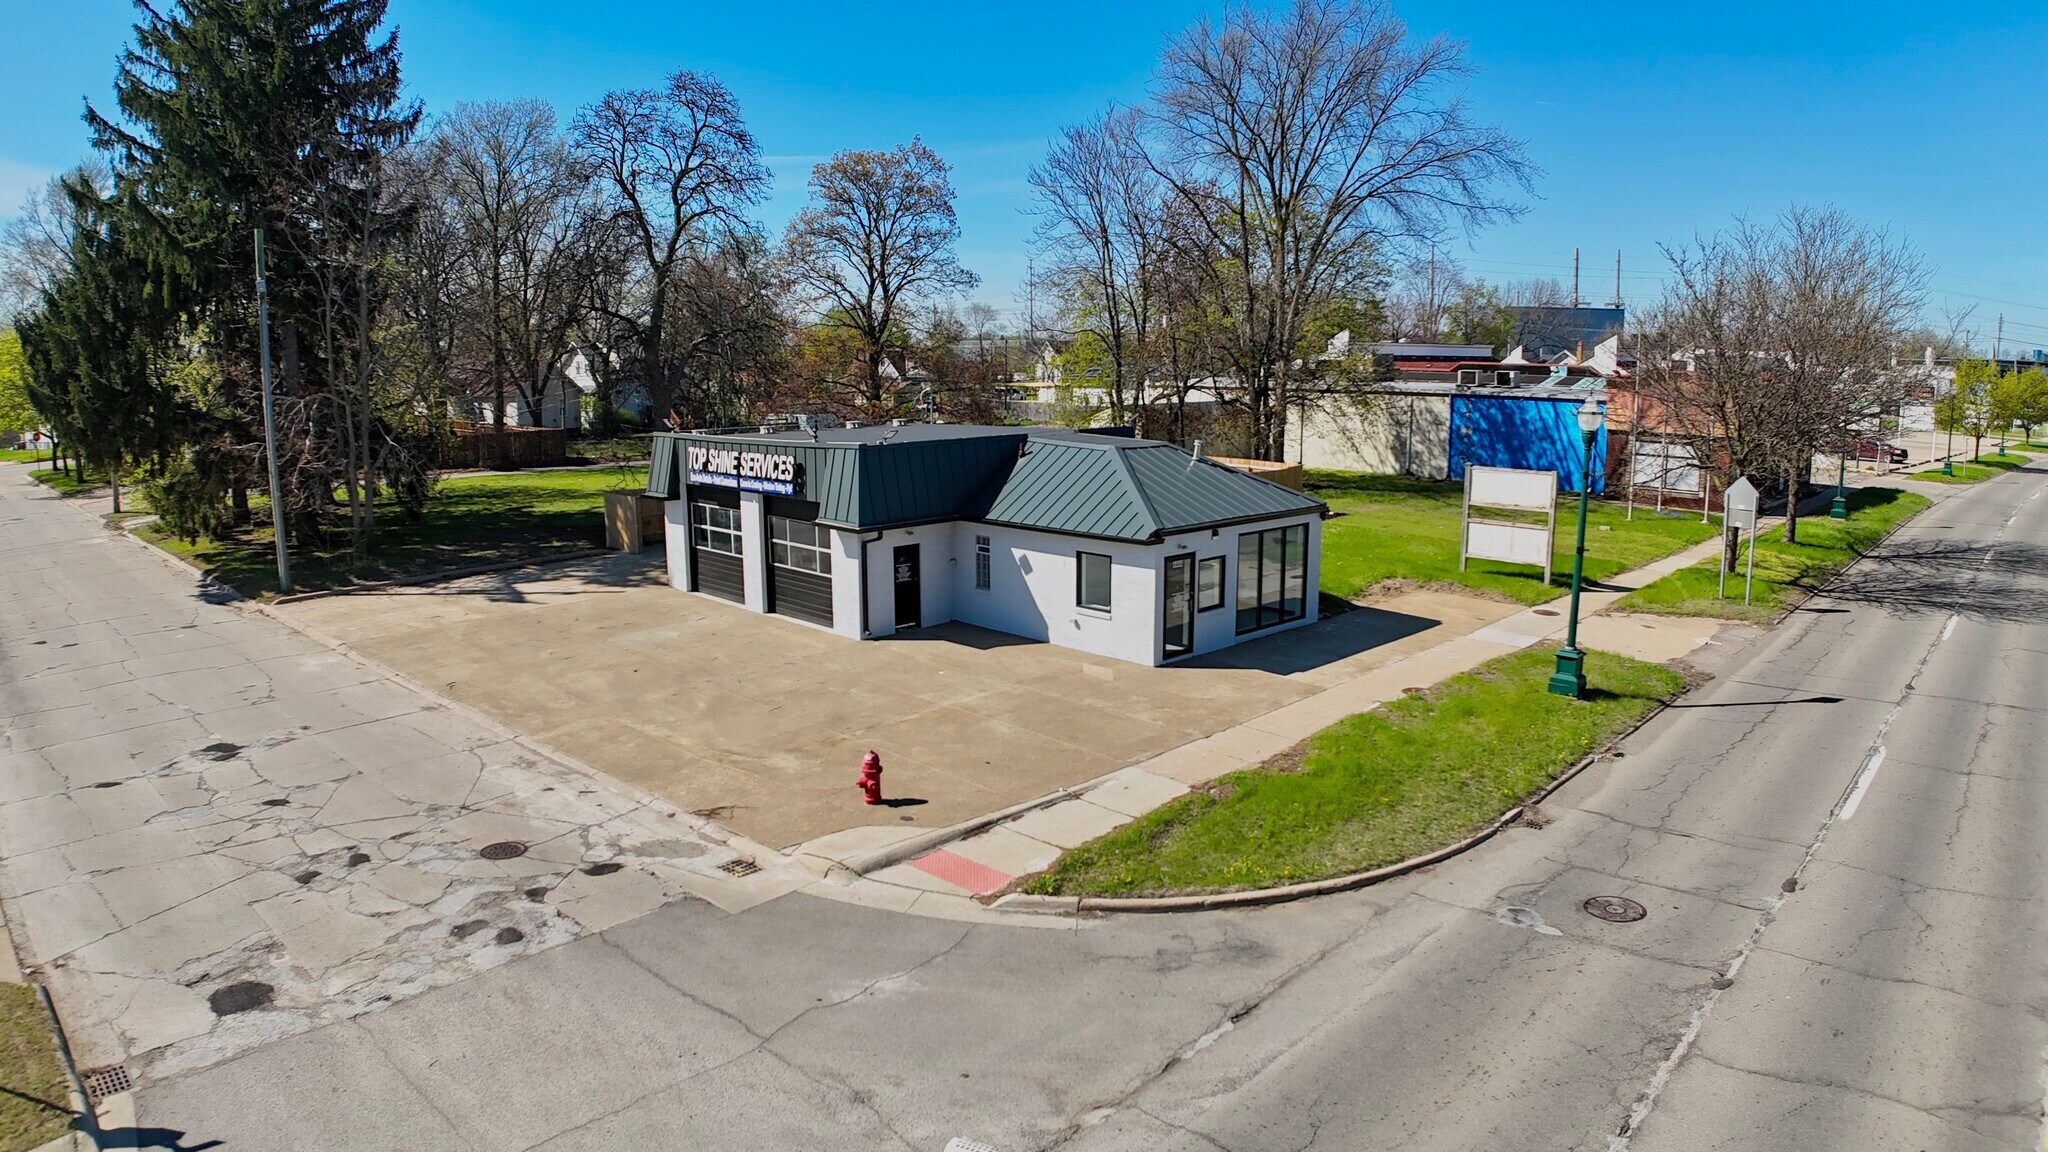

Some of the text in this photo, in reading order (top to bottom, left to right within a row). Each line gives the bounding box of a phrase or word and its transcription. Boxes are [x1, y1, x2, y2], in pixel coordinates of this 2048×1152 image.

[688, 447, 706, 470] TOP
[708, 448, 739, 475] SHINE
[740, 452, 794, 481] SERVICES
